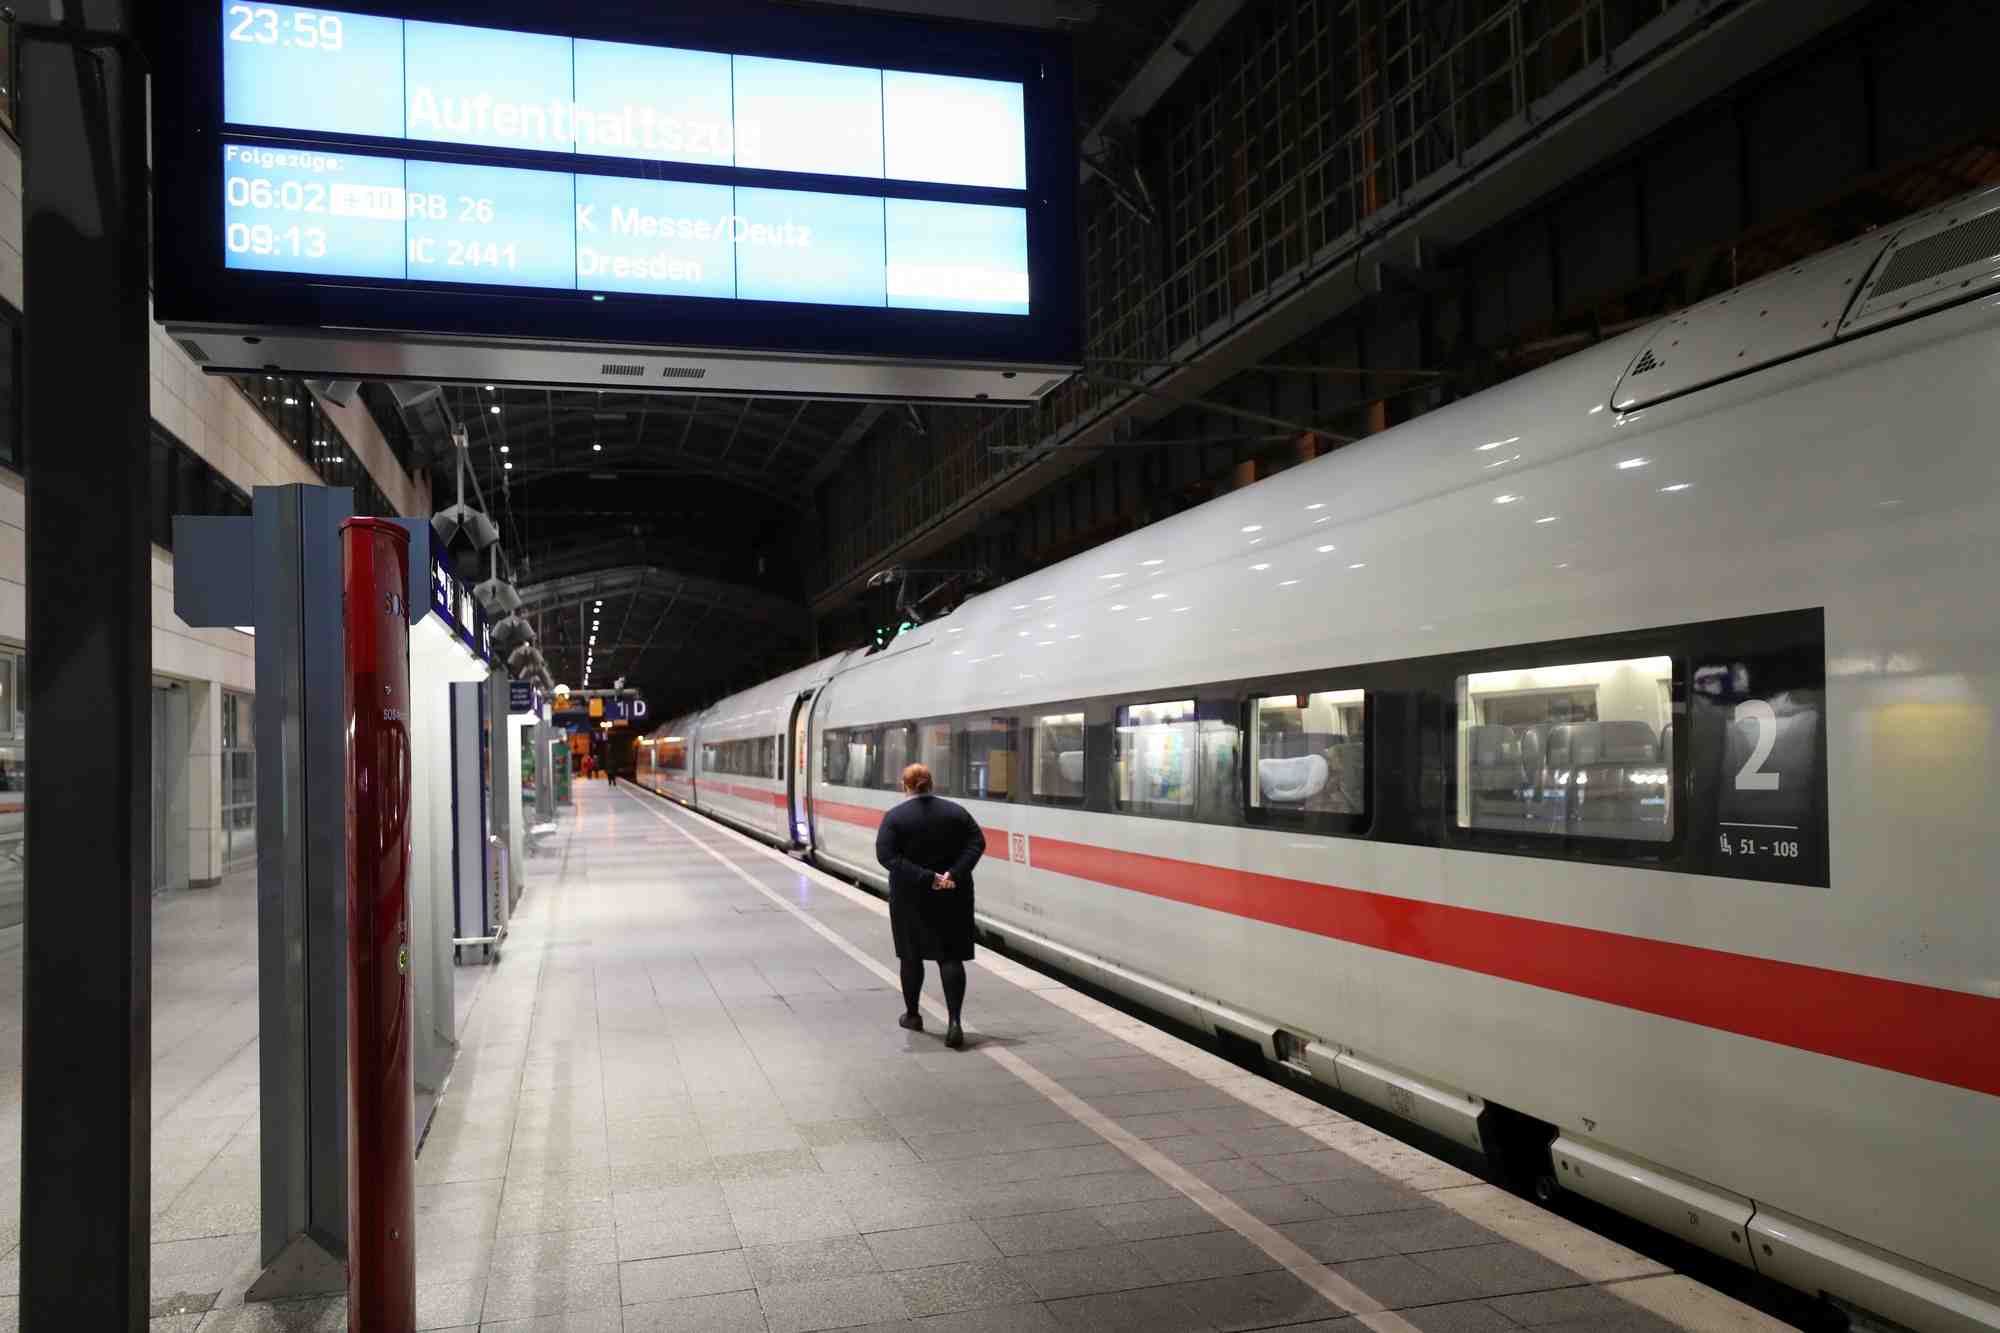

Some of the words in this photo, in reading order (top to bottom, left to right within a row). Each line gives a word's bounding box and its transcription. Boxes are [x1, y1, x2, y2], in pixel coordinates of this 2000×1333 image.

[228, 5, 344, 51] 23:59
[227, 146, 344, 173] Folgezüge:
[227, 177, 328, 213] 06:02
[408, 192, 448, 220] RB
[458, 197, 495, 225] 26
[576, 204, 595, 233] K
[611, 207, 811, 251] Messe/Deutz
[227, 223, 327, 258] 09:13
[408, 237, 435, 263] IC
[447, 240, 518, 271] 2441
[577, 248, 703, 283] Dresden
[633, 700, 647, 716] D
[1734, 699, 1780, 791] 2
[1740, 838, 1756, 855] 51
[1773, 840, 1799, 858] 108
